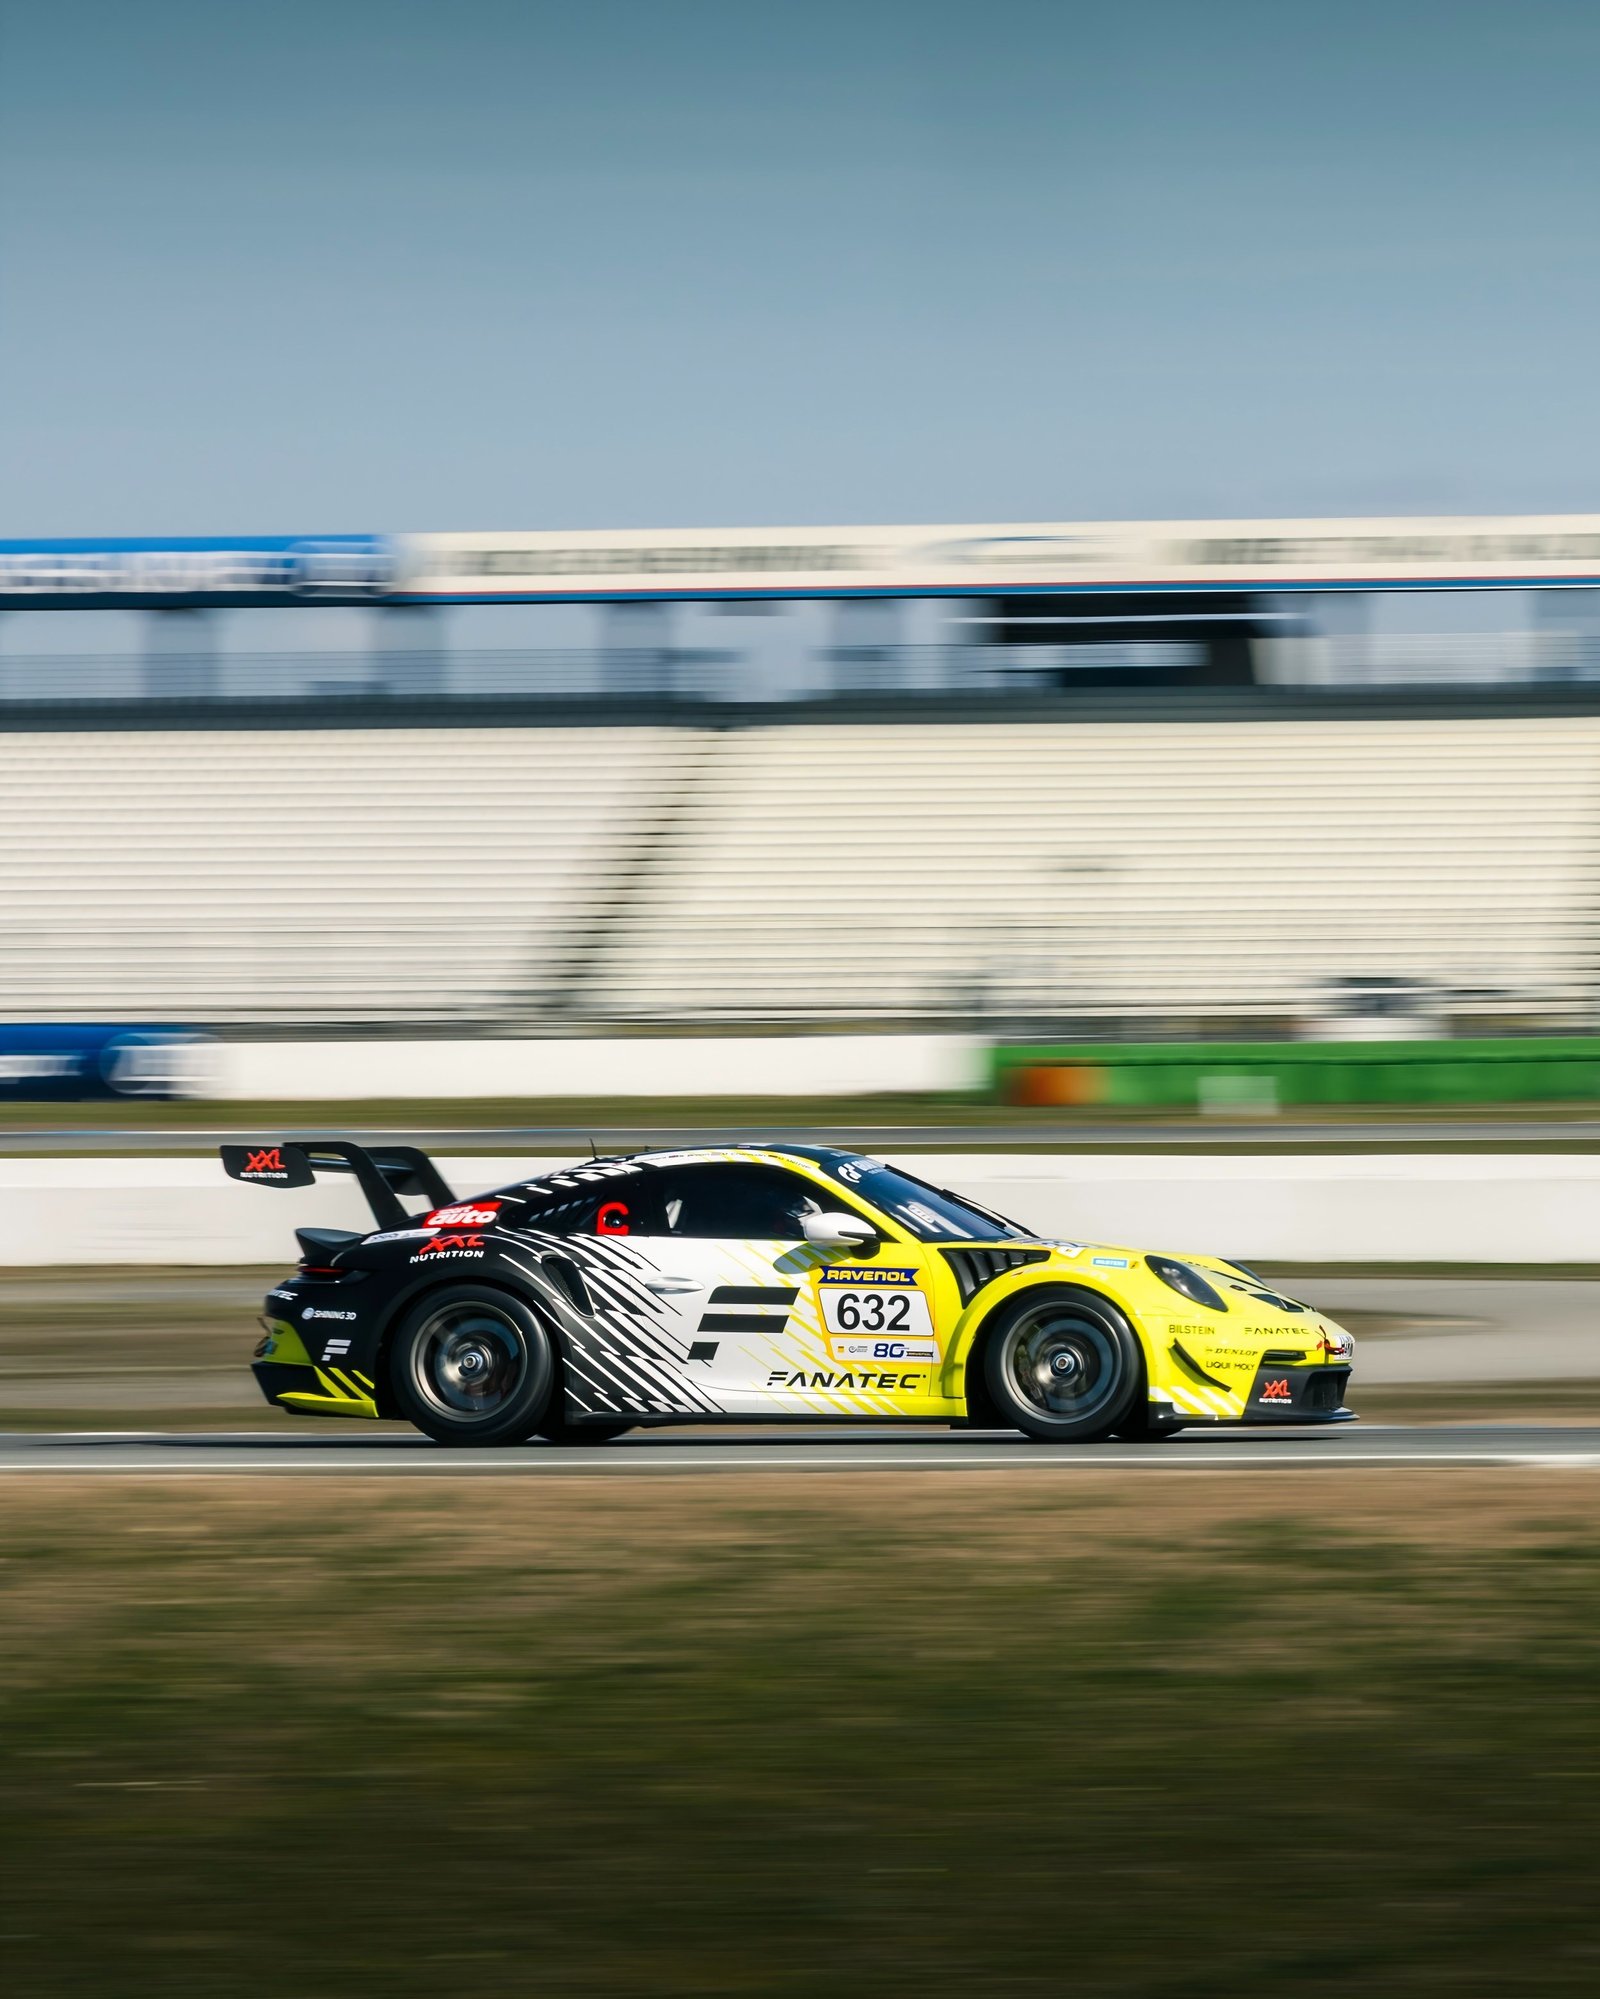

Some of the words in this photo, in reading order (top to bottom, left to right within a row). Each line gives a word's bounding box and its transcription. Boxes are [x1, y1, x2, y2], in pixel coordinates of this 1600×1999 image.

[245, 1149, 286, 1172] XXL
[427, 1210, 497, 1225] auto
[418, 1234, 485, 1255] XXL
[409, 1250, 484, 1264] NUTRITION
[827, 1270, 911, 1282] RAVENOL
[313, 1310, 344, 1320] SHINING
[837, 1293, 910, 1331] 632
[1169, 1324, 1215, 1334] BILSTEIN
[1244, 1327, 1309, 1335] FANATEC
[1215, 1347, 1259, 1357] DUNLOP
[1206, 1361, 1231, 1369] LIQUI
[1234, 1363, 1256, 1371] MOLY
[767, 1371, 921, 1389] FANATEC
[1263, 1379, 1291, 1398] XXL
